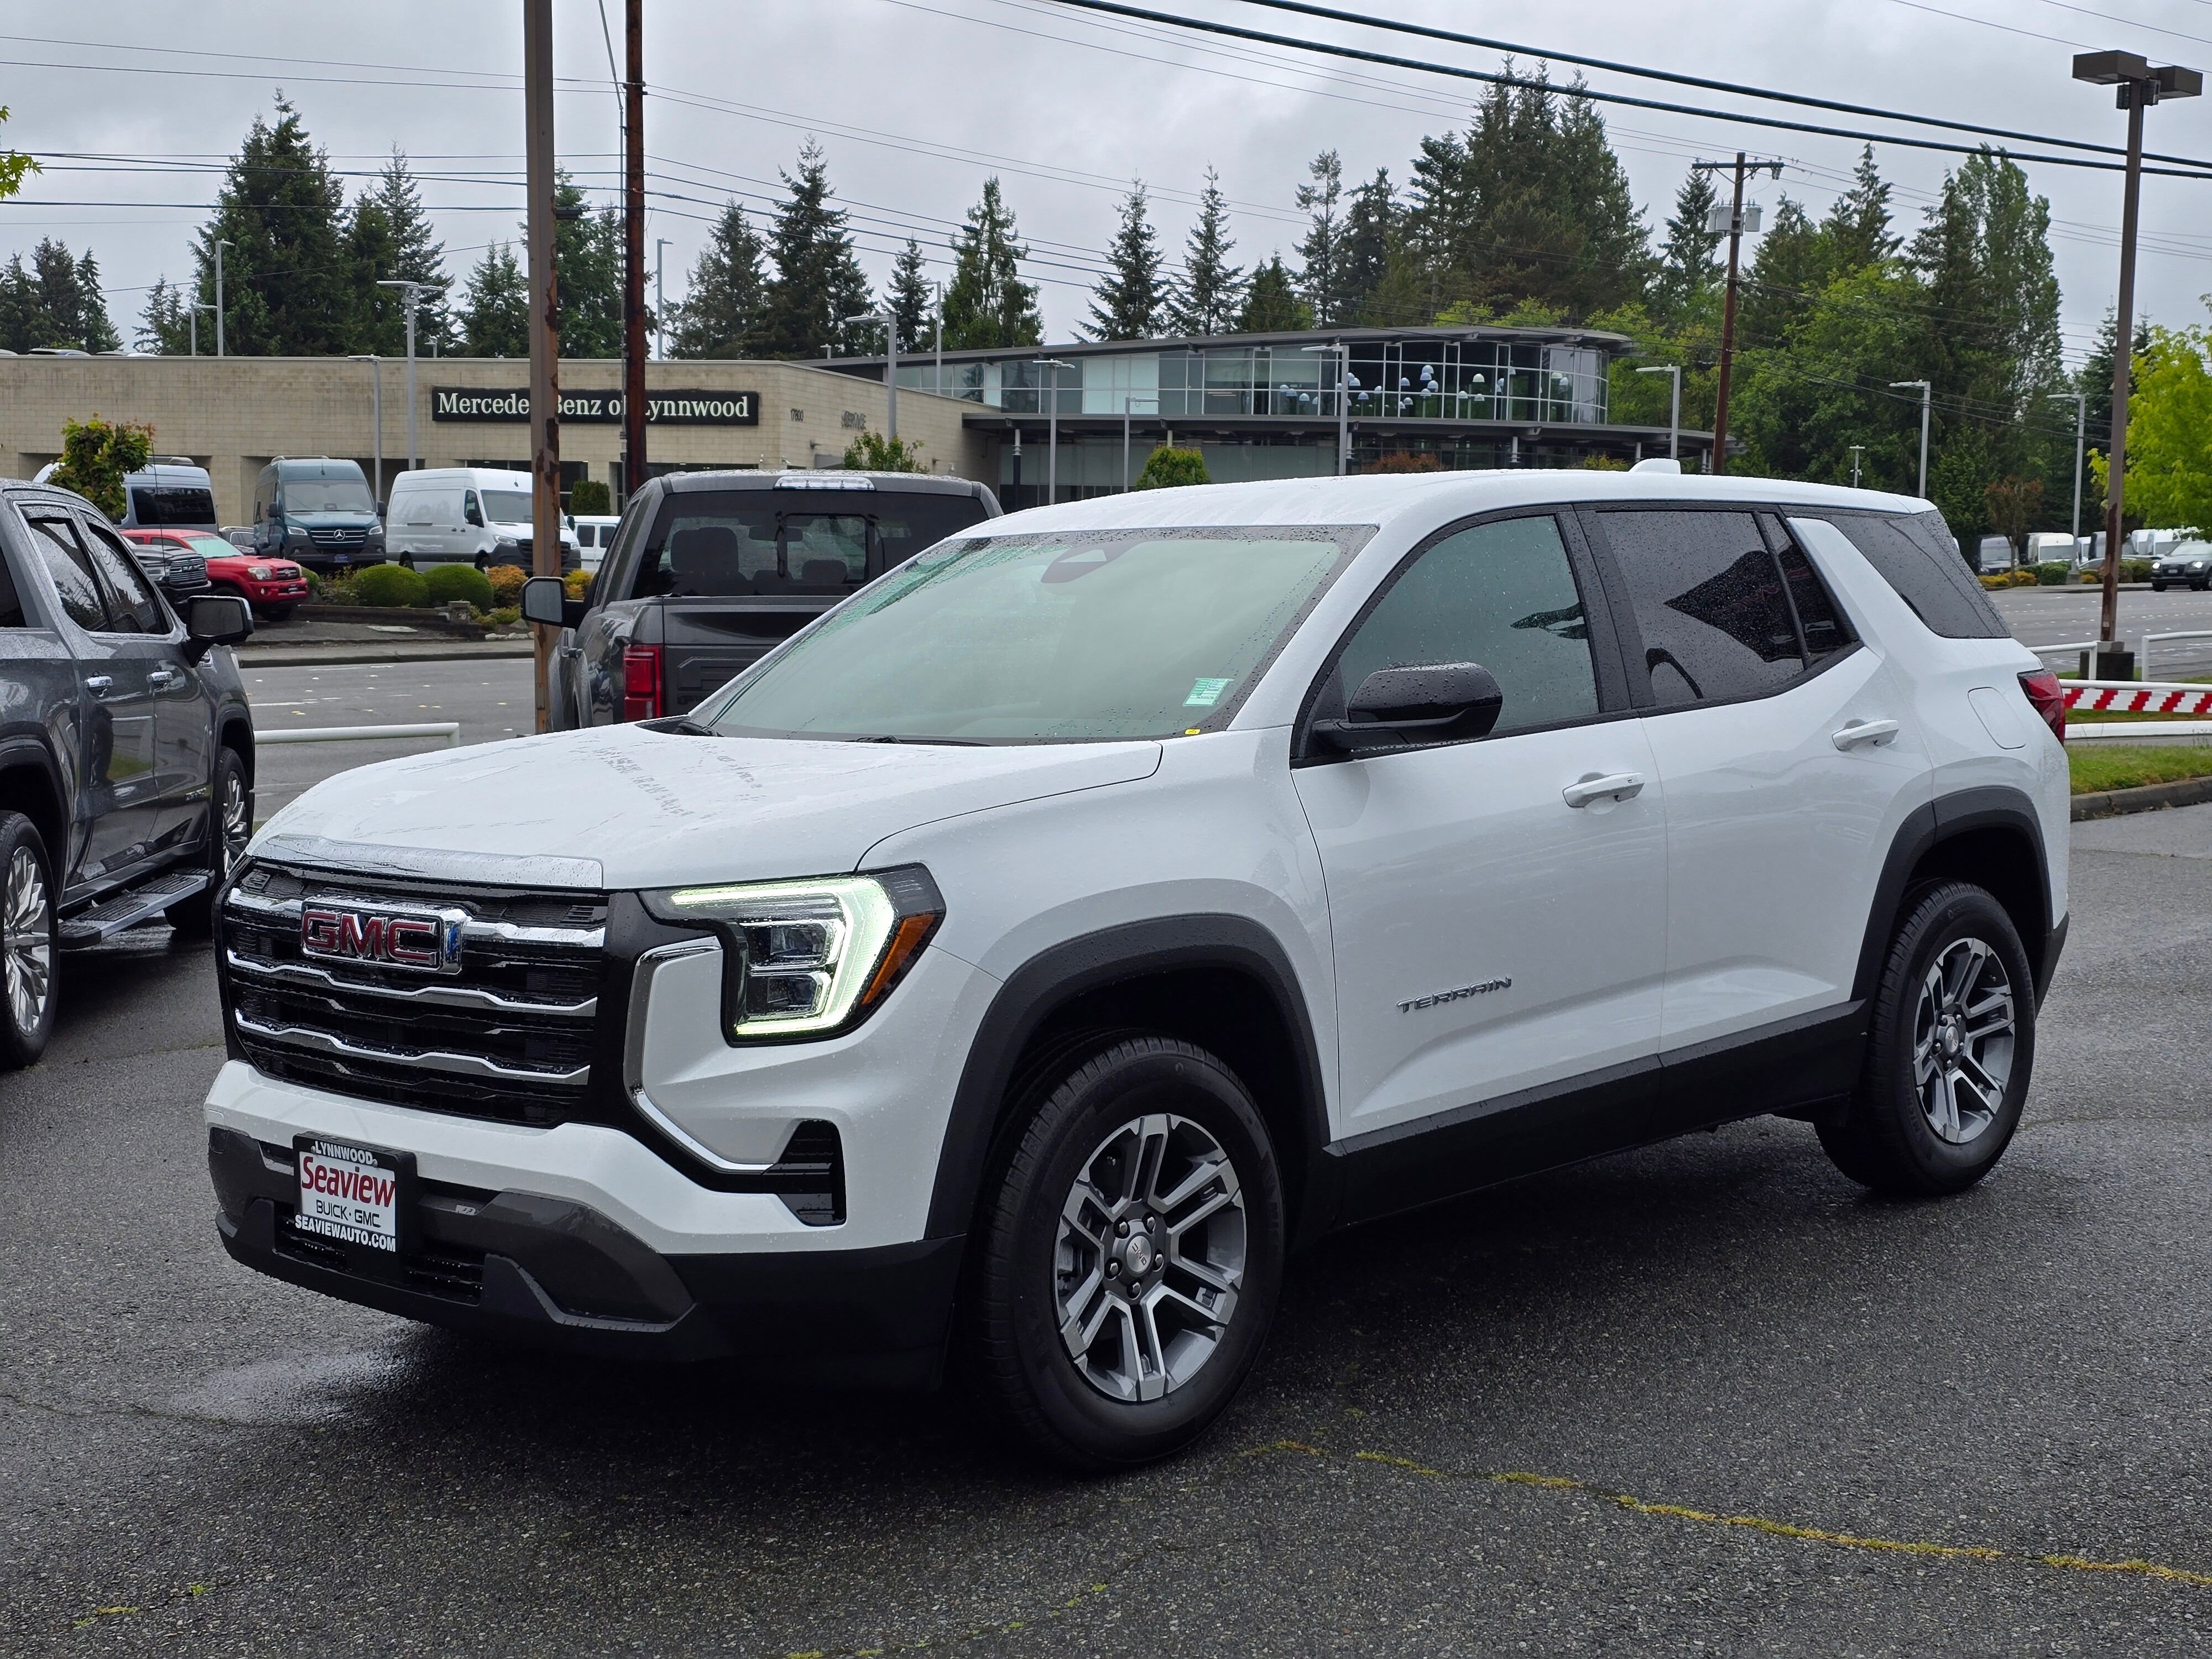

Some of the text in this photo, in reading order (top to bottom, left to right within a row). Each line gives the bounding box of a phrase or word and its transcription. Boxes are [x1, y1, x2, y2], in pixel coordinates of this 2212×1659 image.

[437, 393, 602, 415] Mercedeenz
[302, 910, 437, 966] GMC
[1396, 977, 1511, 1013] TERRAIN
[315, 1141, 373, 1165] LYNNWOOD
[301, 1156, 396, 1208] Seaview
[316, 1199, 381, 1228] BUICK GMC
[295, 1214, 396, 1253] SEAVIEWAUTO.COM
[1131, 1242, 1147, 1266] GMC
